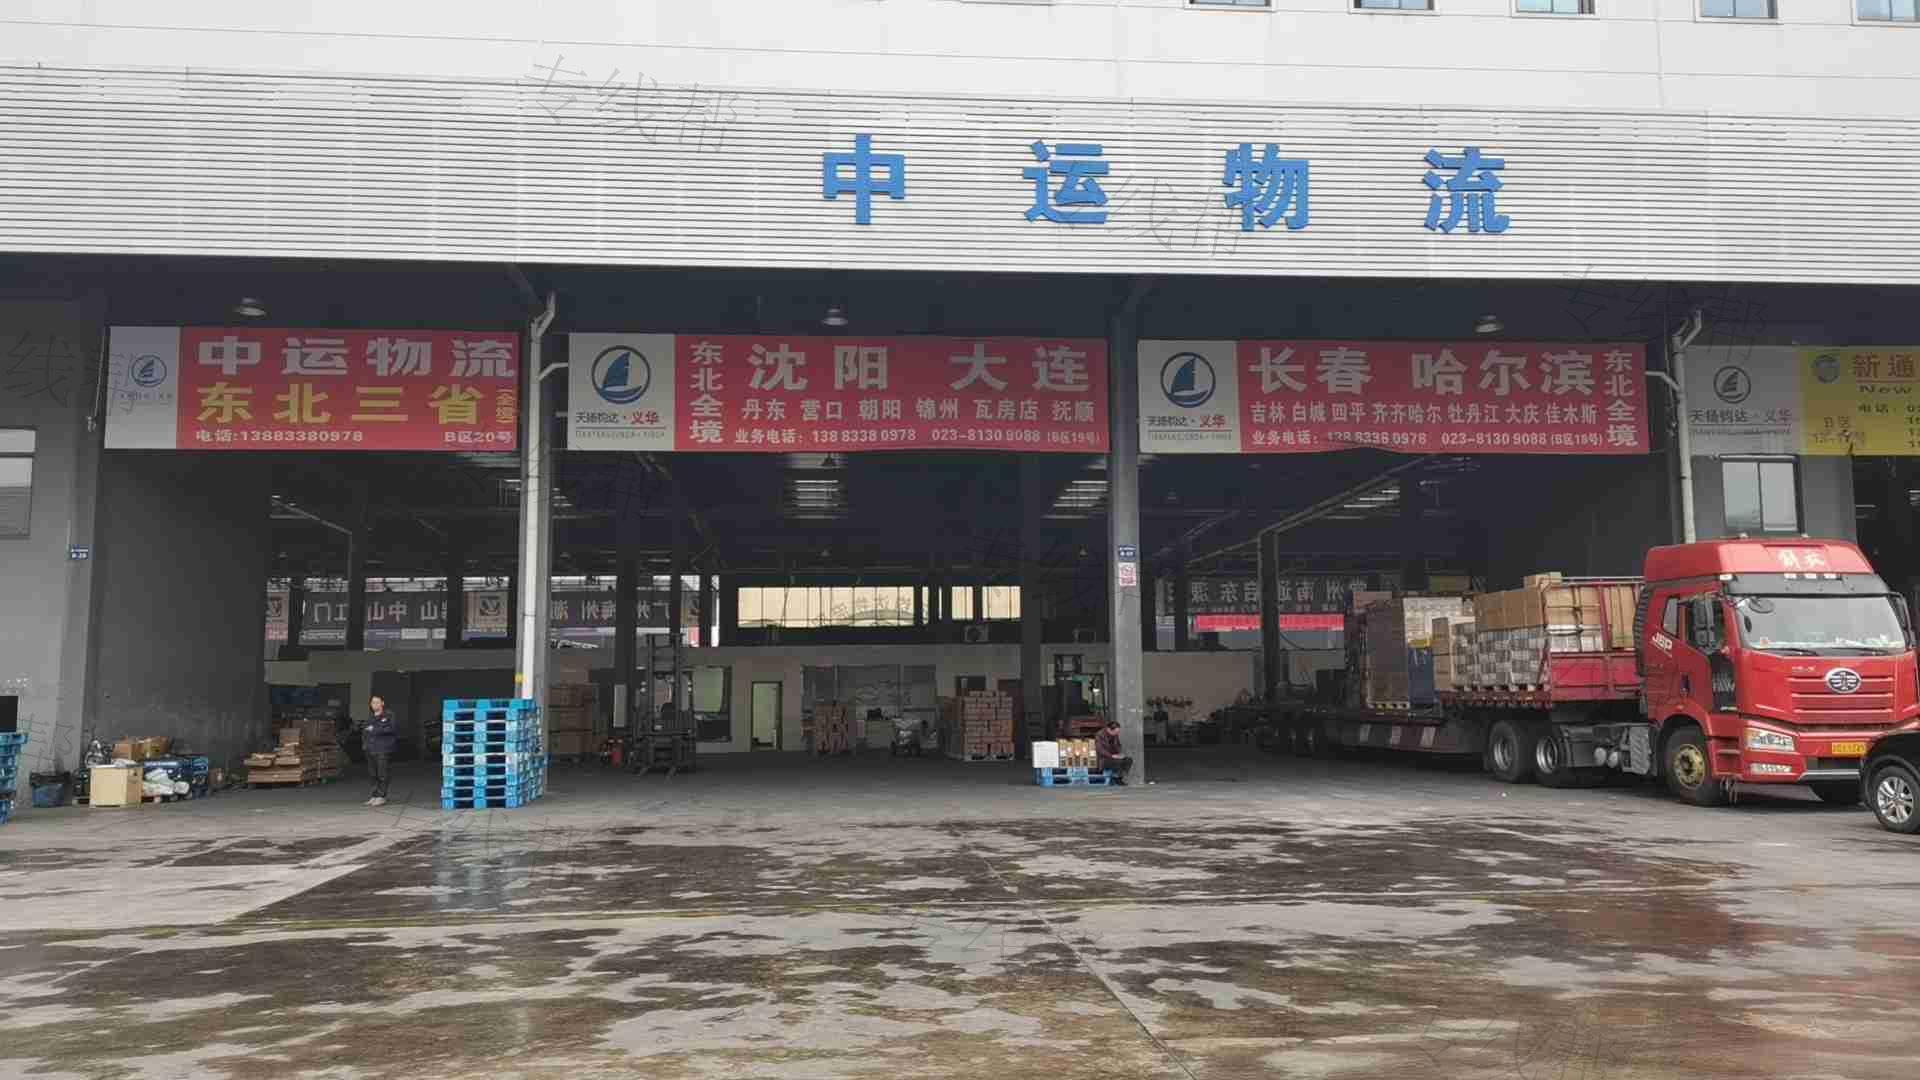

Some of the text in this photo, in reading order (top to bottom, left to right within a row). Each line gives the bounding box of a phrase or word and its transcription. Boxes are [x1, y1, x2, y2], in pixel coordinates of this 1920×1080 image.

[822, 134, 1510, 235] 中运物流
[198, 336, 515, 377] 中运物流
[747, 343, 1089, 393] 沈阳 大连
[1249, 346, 1596, 396] 长春 哈尔滨
[196, 382, 484, 425] 东北三省
[689, 341, 724, 444] 东北全境
[741, 398, 1096, 423] 丹东 营口 朝阳 锦州 瓦房店 抚顺
[1252, 402, 1598, 425] 吉林 白城 四平 齐齐哈尔 牡丹江 大庆 佳木斯
[1603, 349, 1639, 447] 东北全境
